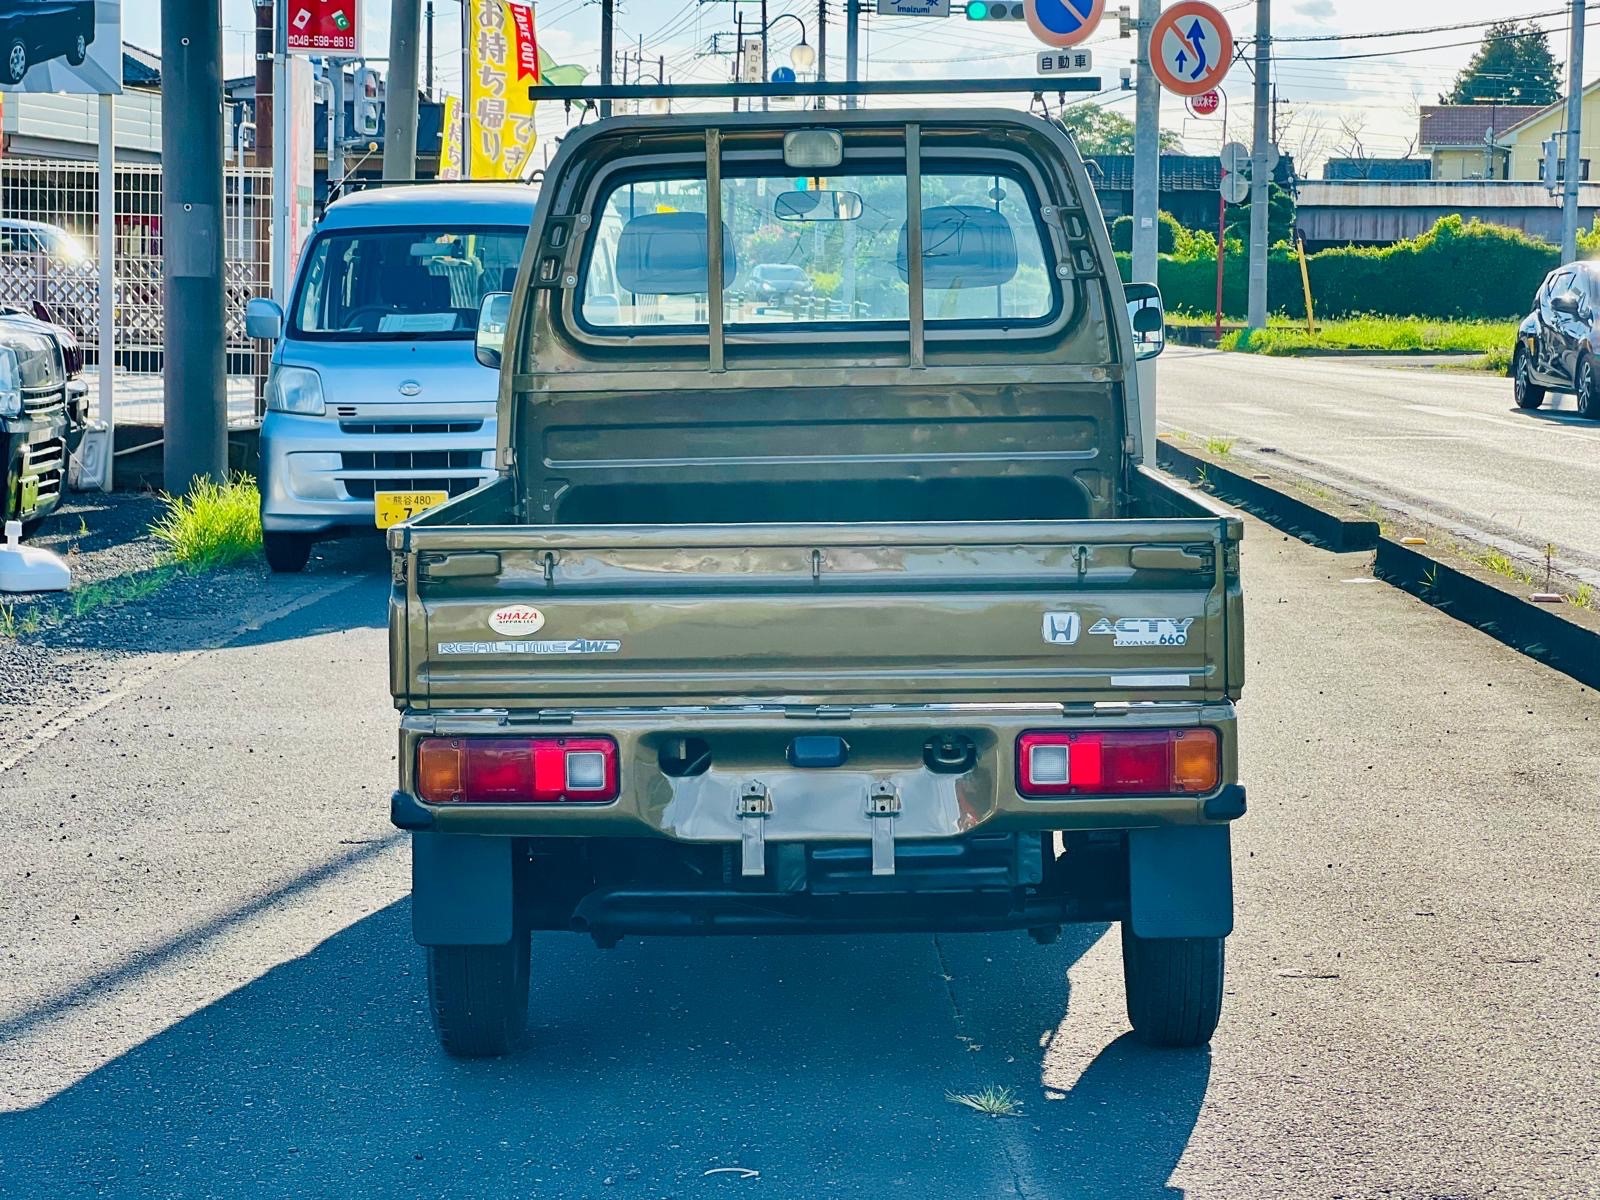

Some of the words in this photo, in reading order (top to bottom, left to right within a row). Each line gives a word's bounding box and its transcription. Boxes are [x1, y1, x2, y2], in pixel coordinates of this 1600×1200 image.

[897, 5, 930, 14] Imaizumi
[513, 5, 531, 41] TAKE
[293, 35, 354, 48] 048-598-8619
[521, 41, 535, 71] OUT
[1041, 54, 1087, 70] 自動車
[478, 0, 506, 161] お持ち帰り
[496, 612, 537, 620] SHAZA
[1089, 618, 1194, 633] ACTY
[1158, 633, 1186, 646] 660
